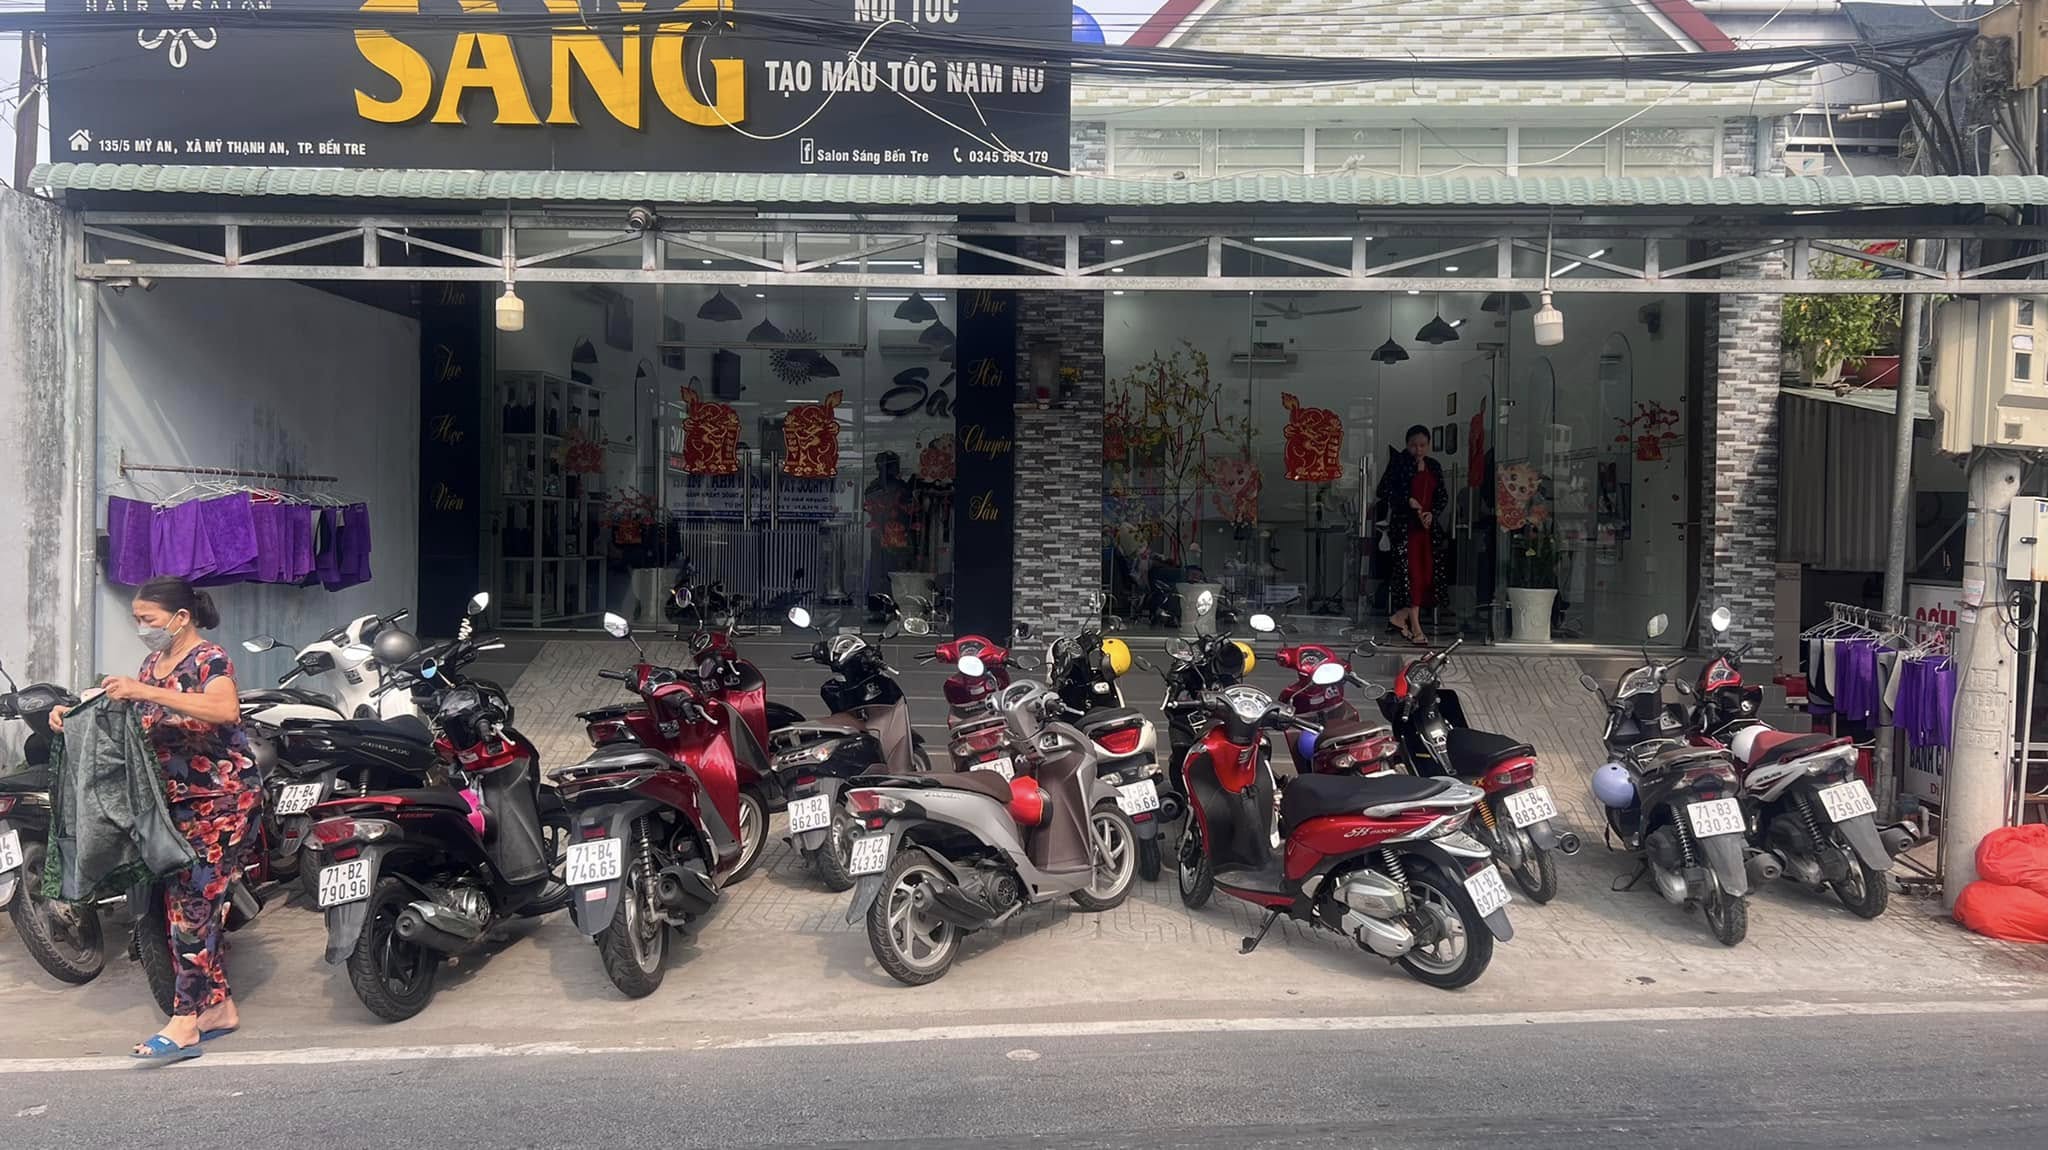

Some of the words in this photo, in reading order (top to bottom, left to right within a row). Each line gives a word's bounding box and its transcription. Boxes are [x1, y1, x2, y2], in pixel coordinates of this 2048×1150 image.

[764, 60, 812, 97] TẠO
[886, 53, 938, 92] TÓC
[946, 61, 1003, 93] NAM
[98, 139, 130, 152] 135/5
[185, 137, 202, 153] XÃ
[204, 138, 223, 154] MỸ
[226, 140, 265, 156] THẠNH
[298, 142, 315, 155] TP.
[318, 138, 341, 156] BẾN
[344, 142, 367, 156] TRE
[816, 149, 850, 163] Salon
[852, 149, 881, 165] Sáng
[884, 148, 906, 163] Bến
[910, 149, 930, 163] Tre
[968, 150, 999, 164] 0345
[1027, 150, 1049, 163] 179
[1512, 791, 1544, 811] 71-B4
[1828, 796, 1873, 820] 759.08
[1514, 801, 1554, 825] 883.33
[1695, 815, 1742, 835] 230.33
[575, 842, 613, 864] 71-B4
[856, 838, 884, 857] 71-C2
[326, 862, 363, 886] 71-B2
[570, 859, 617, 882] 746.65
[320, 879, 367, 905] 790.96
